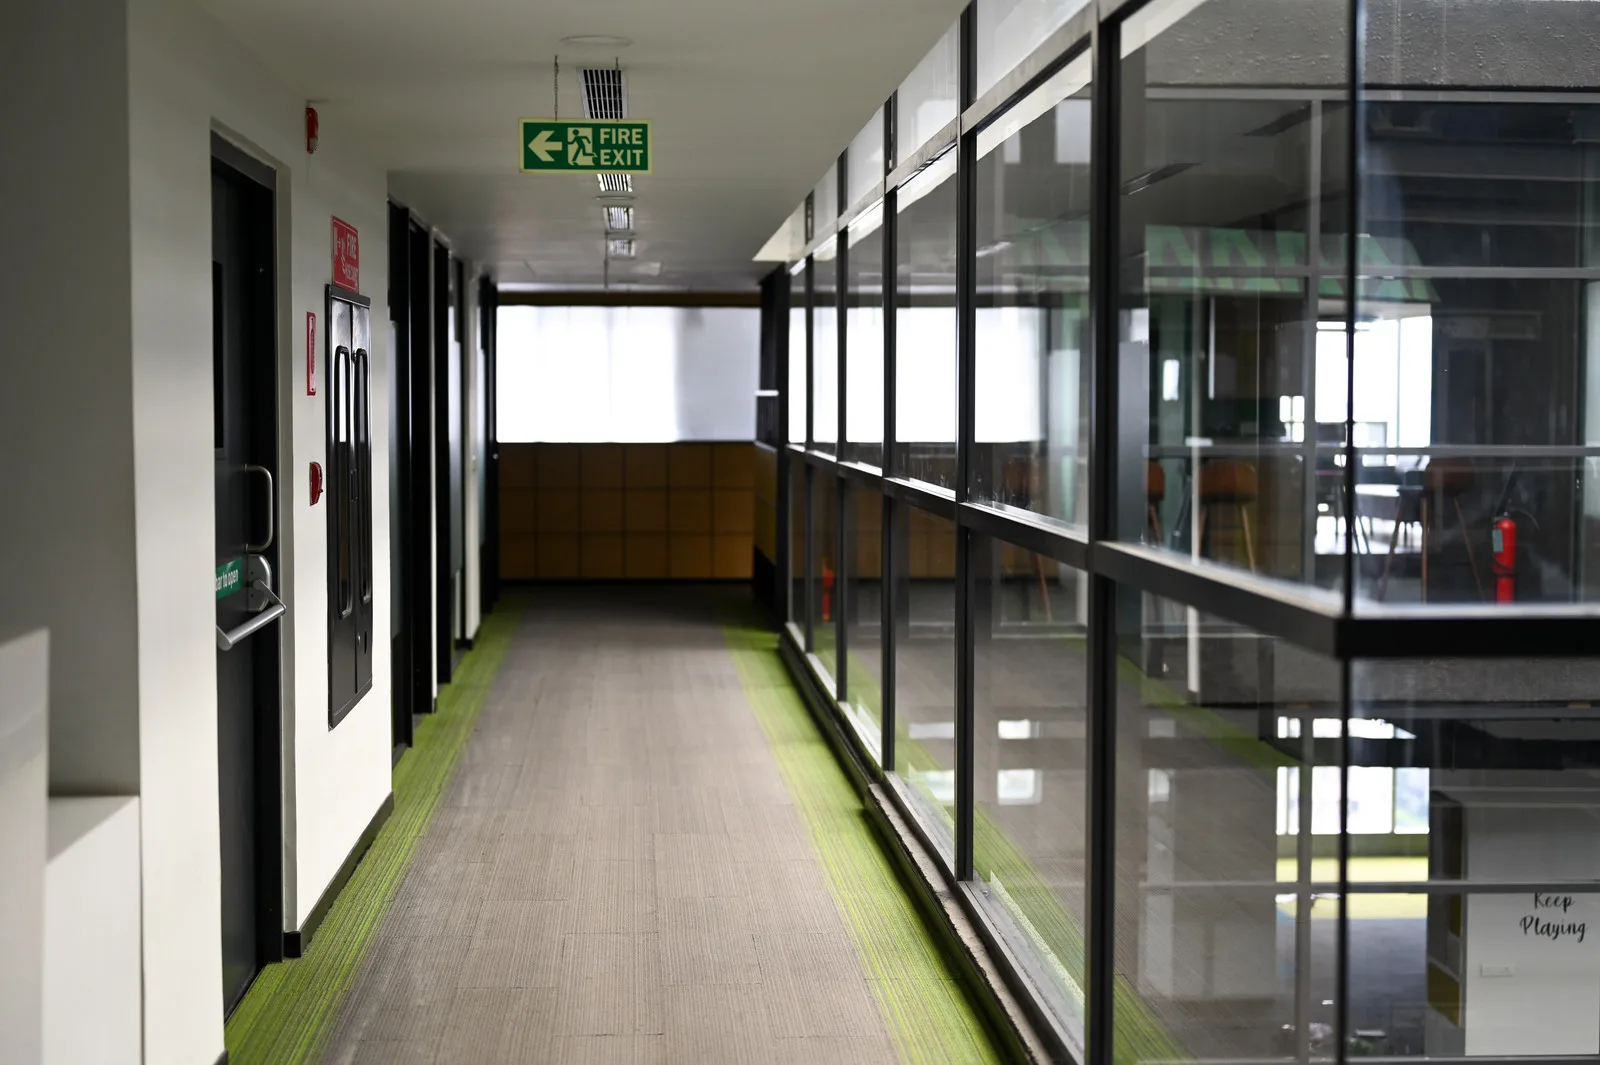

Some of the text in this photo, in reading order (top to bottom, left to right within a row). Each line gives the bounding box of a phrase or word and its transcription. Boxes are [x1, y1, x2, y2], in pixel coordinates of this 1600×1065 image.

[599, 128, 643, 145] FIRE
[600, 149, 644, 166] EXIT
[222, 572, 228, 588] to
[228, 569, 239, 589] open
[1534, 892, 1574, 913] Keep
[1519, 915, 1588, 943] Playing
